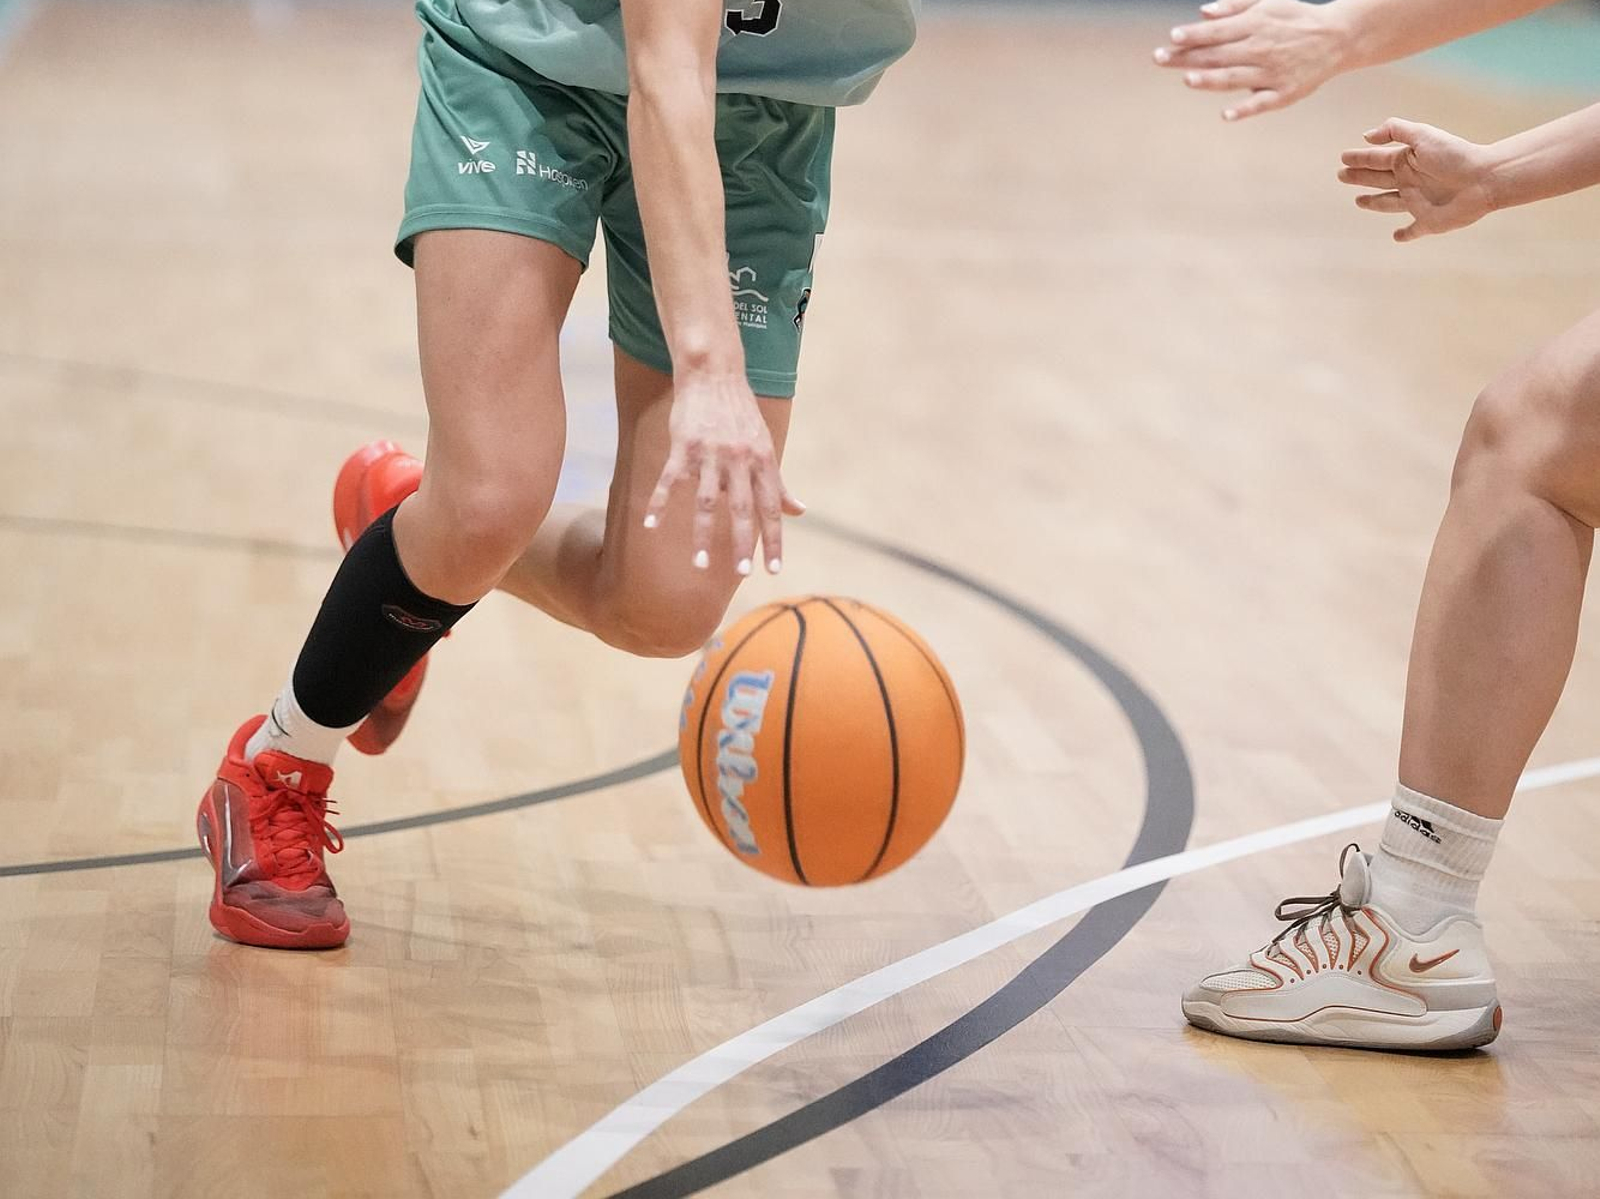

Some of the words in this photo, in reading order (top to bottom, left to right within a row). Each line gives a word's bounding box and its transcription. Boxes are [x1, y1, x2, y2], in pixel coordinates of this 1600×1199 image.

[458, 159, 496, 175] vive
[751, 303, 768, 315] SOL
[734, 311, 768, 324] ENTAL
[1394, 810, 1442, 845] adidas
